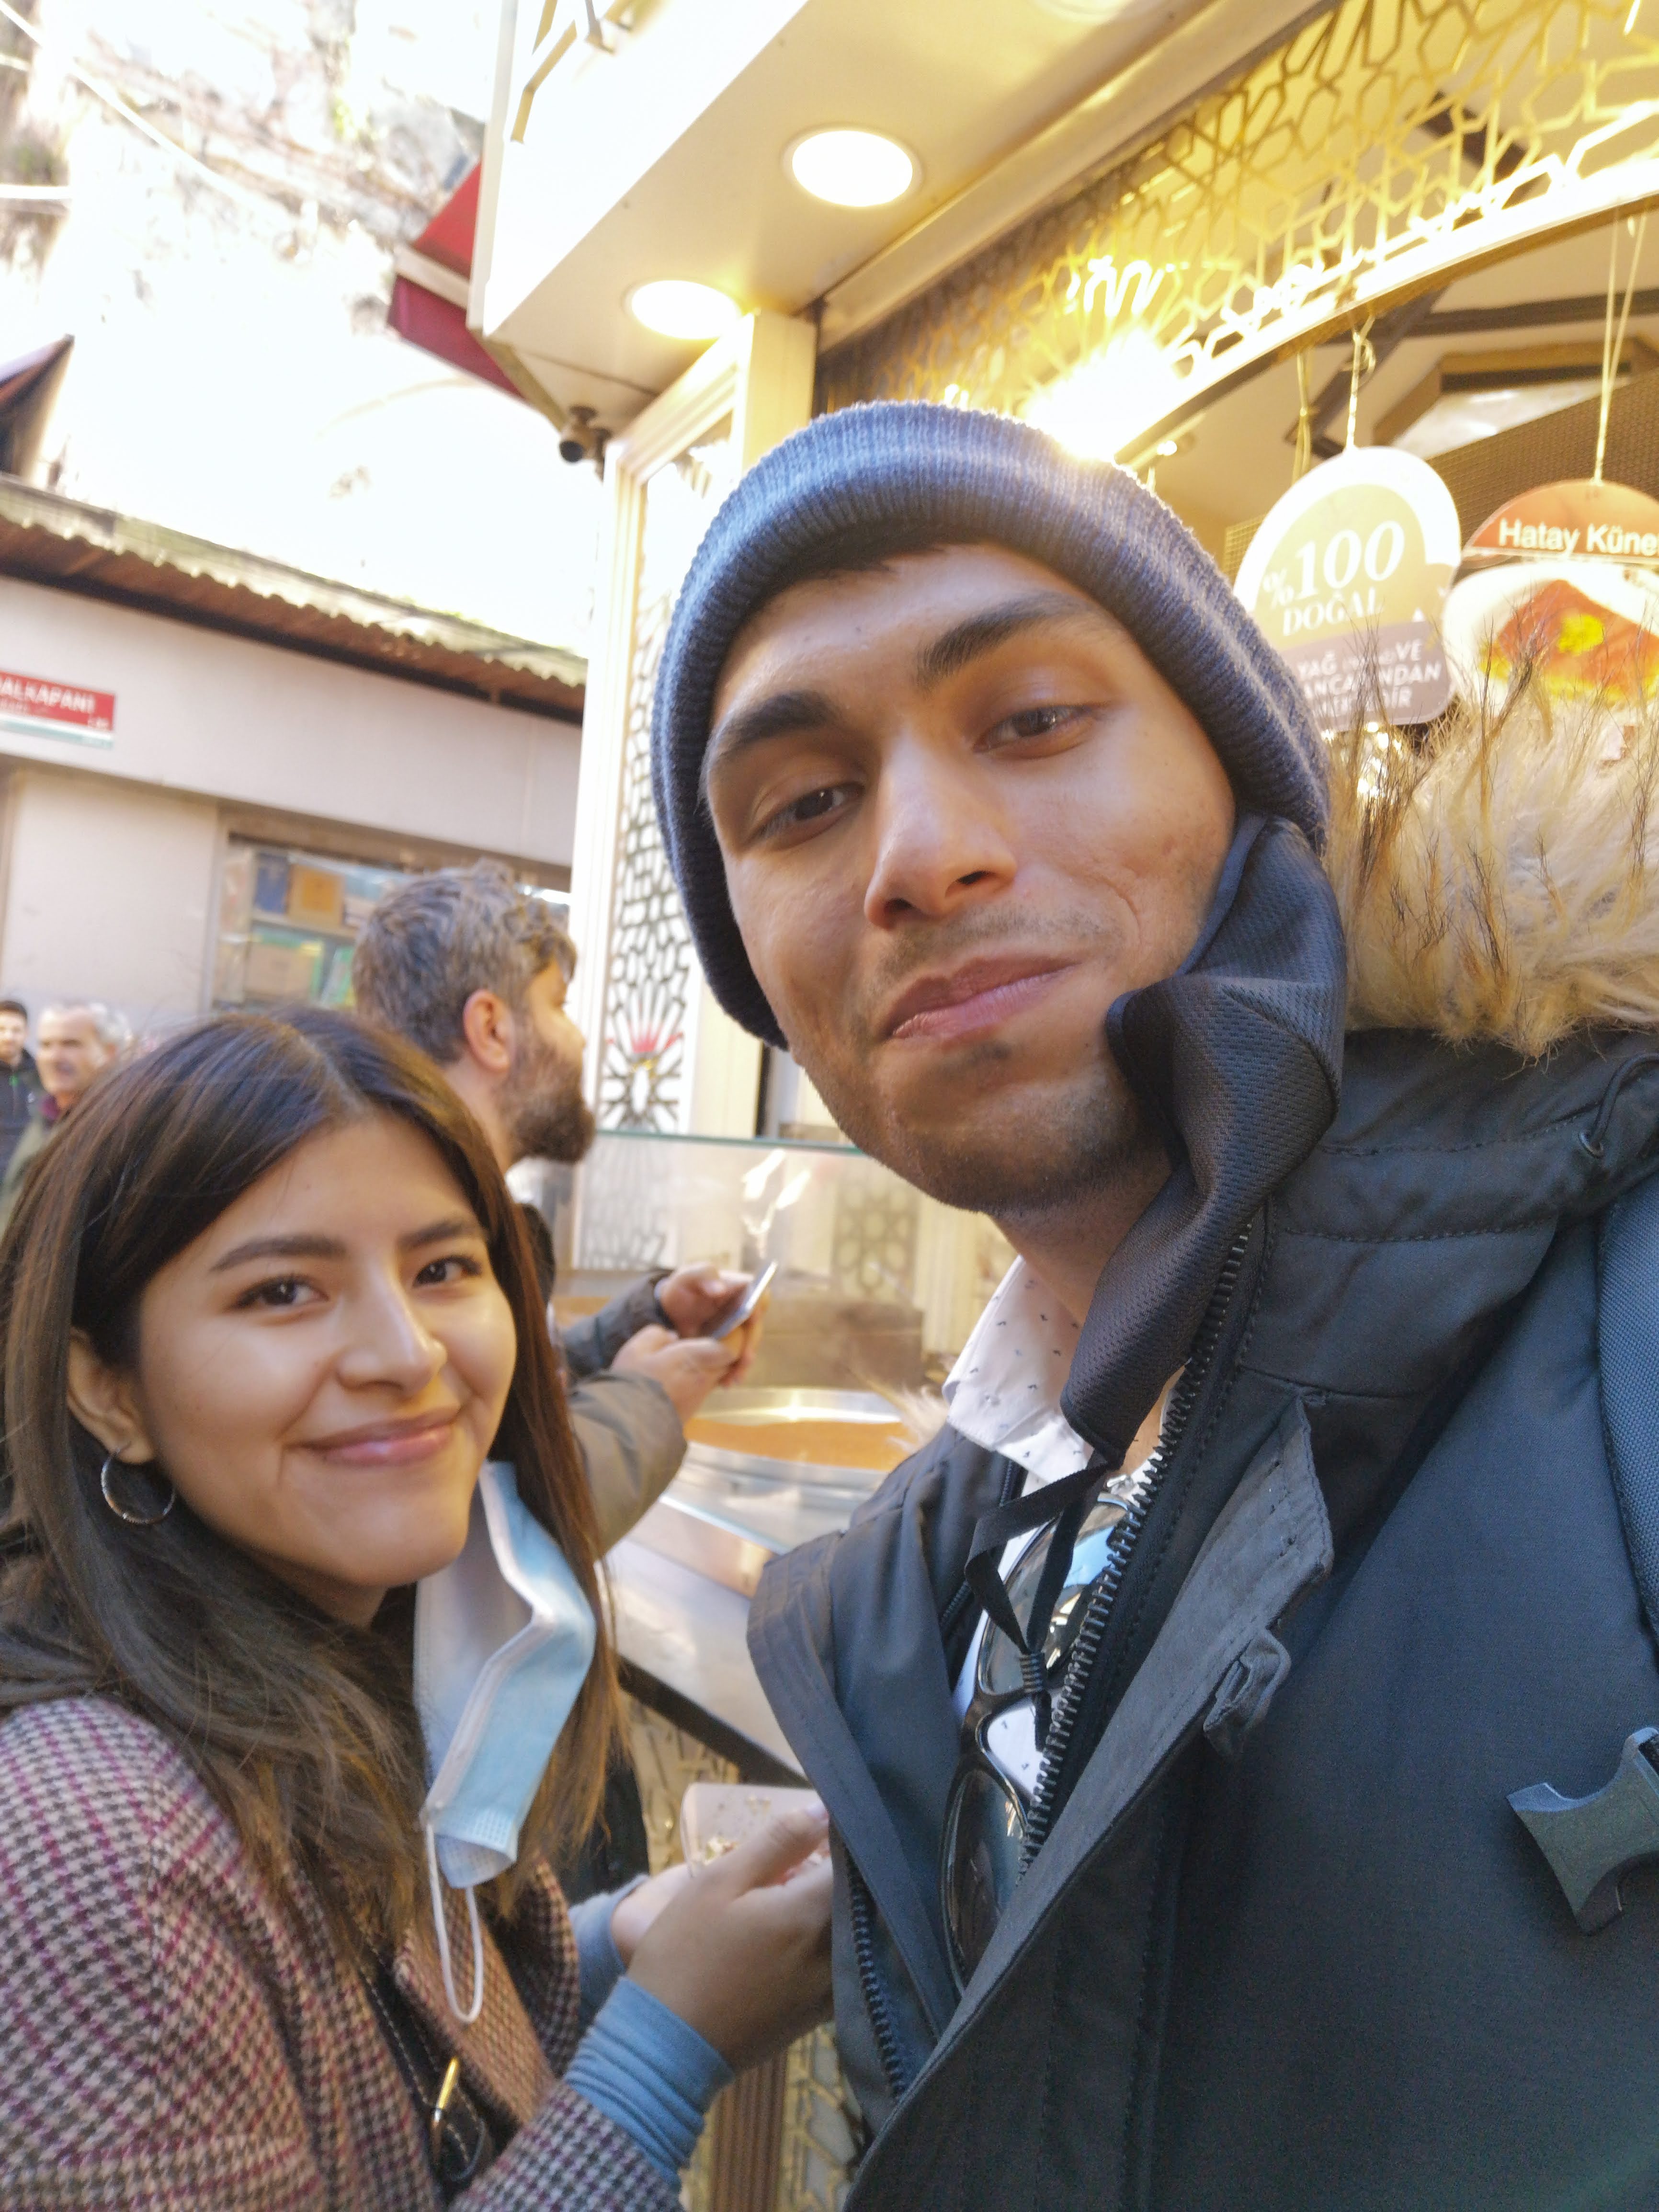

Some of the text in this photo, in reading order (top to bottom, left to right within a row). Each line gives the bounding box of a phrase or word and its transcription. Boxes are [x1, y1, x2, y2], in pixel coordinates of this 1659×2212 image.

[1499, 517, 1659, 559] Hatay Küne
[1262, 520, 1405, 609] %100
[1283, 587, 1382, 637] DOĞAL
[0, 674, 95, 714] ALKAPANI
